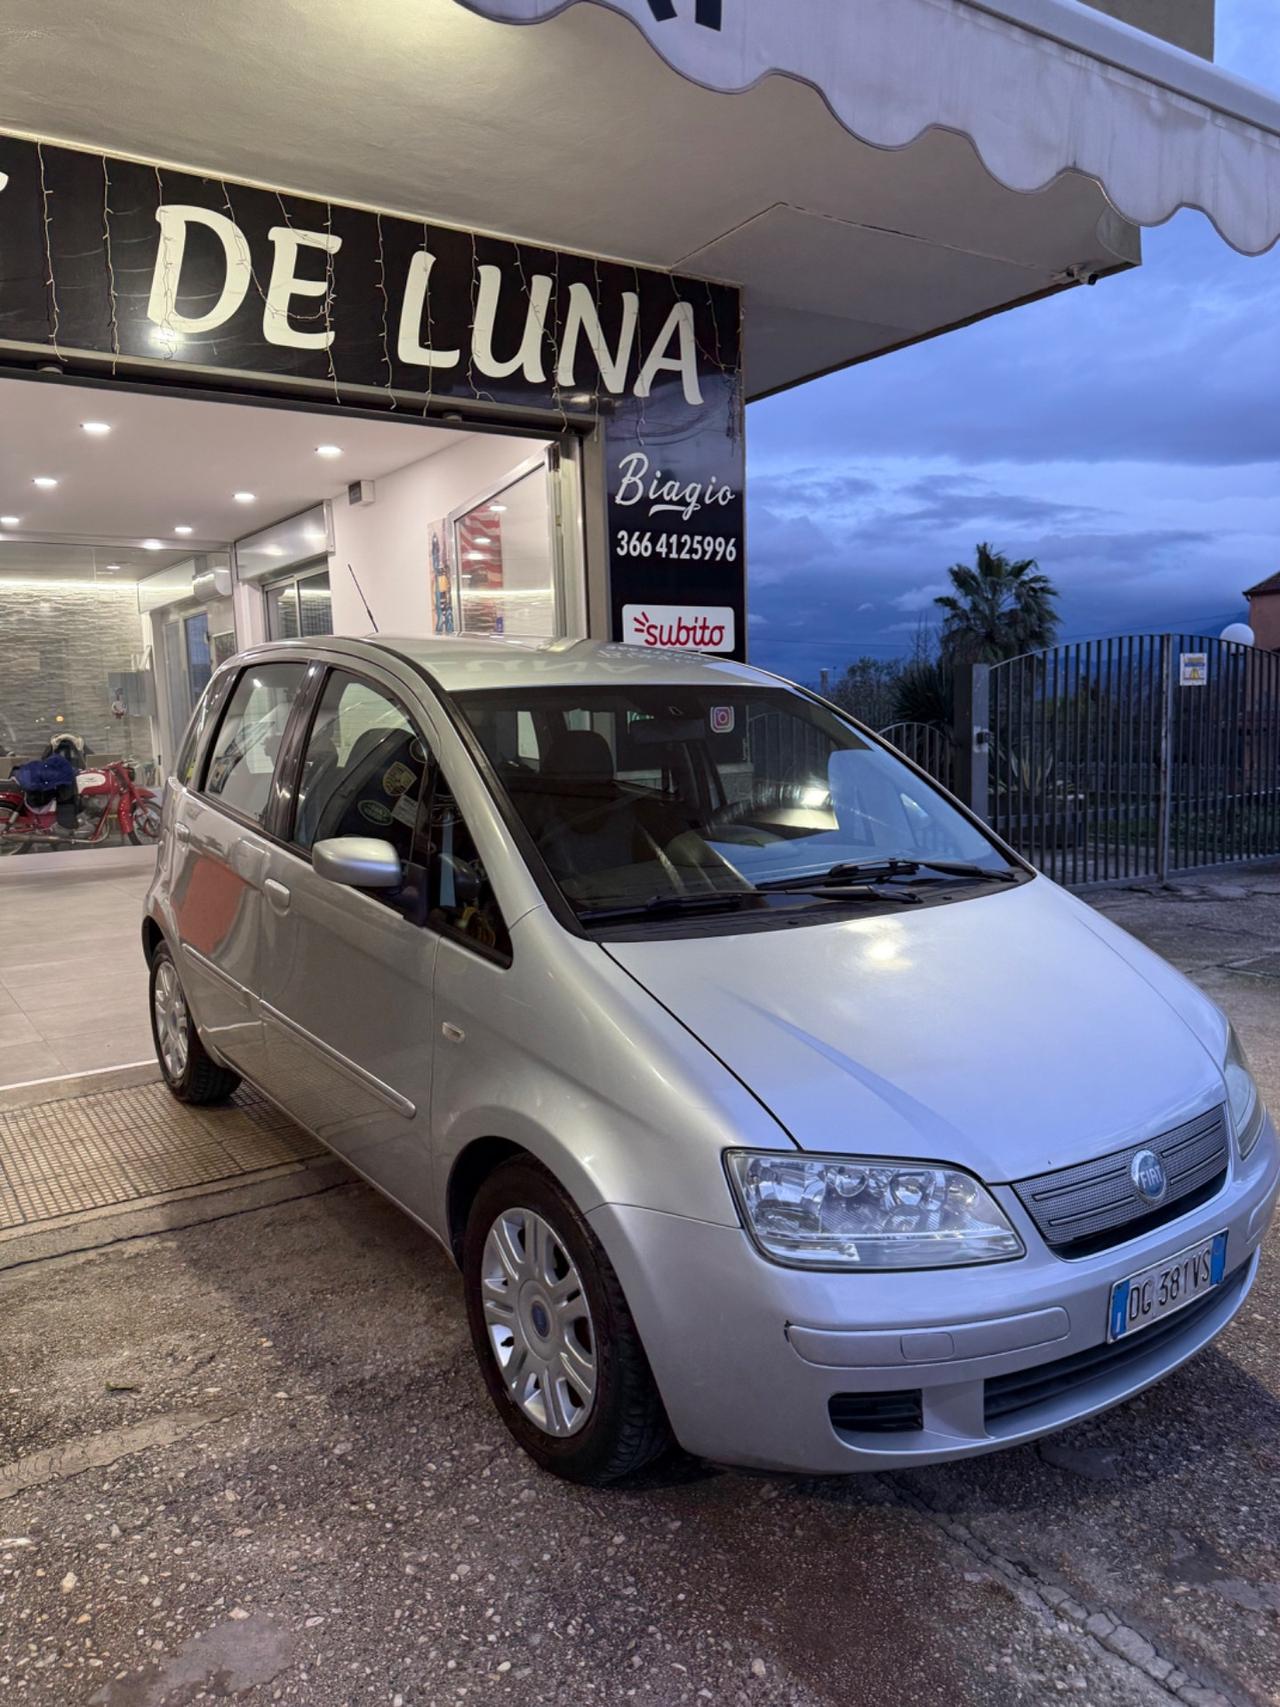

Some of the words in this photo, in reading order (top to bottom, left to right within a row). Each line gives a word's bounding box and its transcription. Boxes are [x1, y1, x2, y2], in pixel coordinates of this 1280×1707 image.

[147, 204, 342, 349] DE
[398, 250, 704, 405] LUNA
[615, 452, 735, 521] Biagio
[616, 530, 652, 557] 366
[655, 533, 737, 562] 4125996
[644, 616, 725, 646] subito
[1139, 1165, 1163, 1189] FIAT
